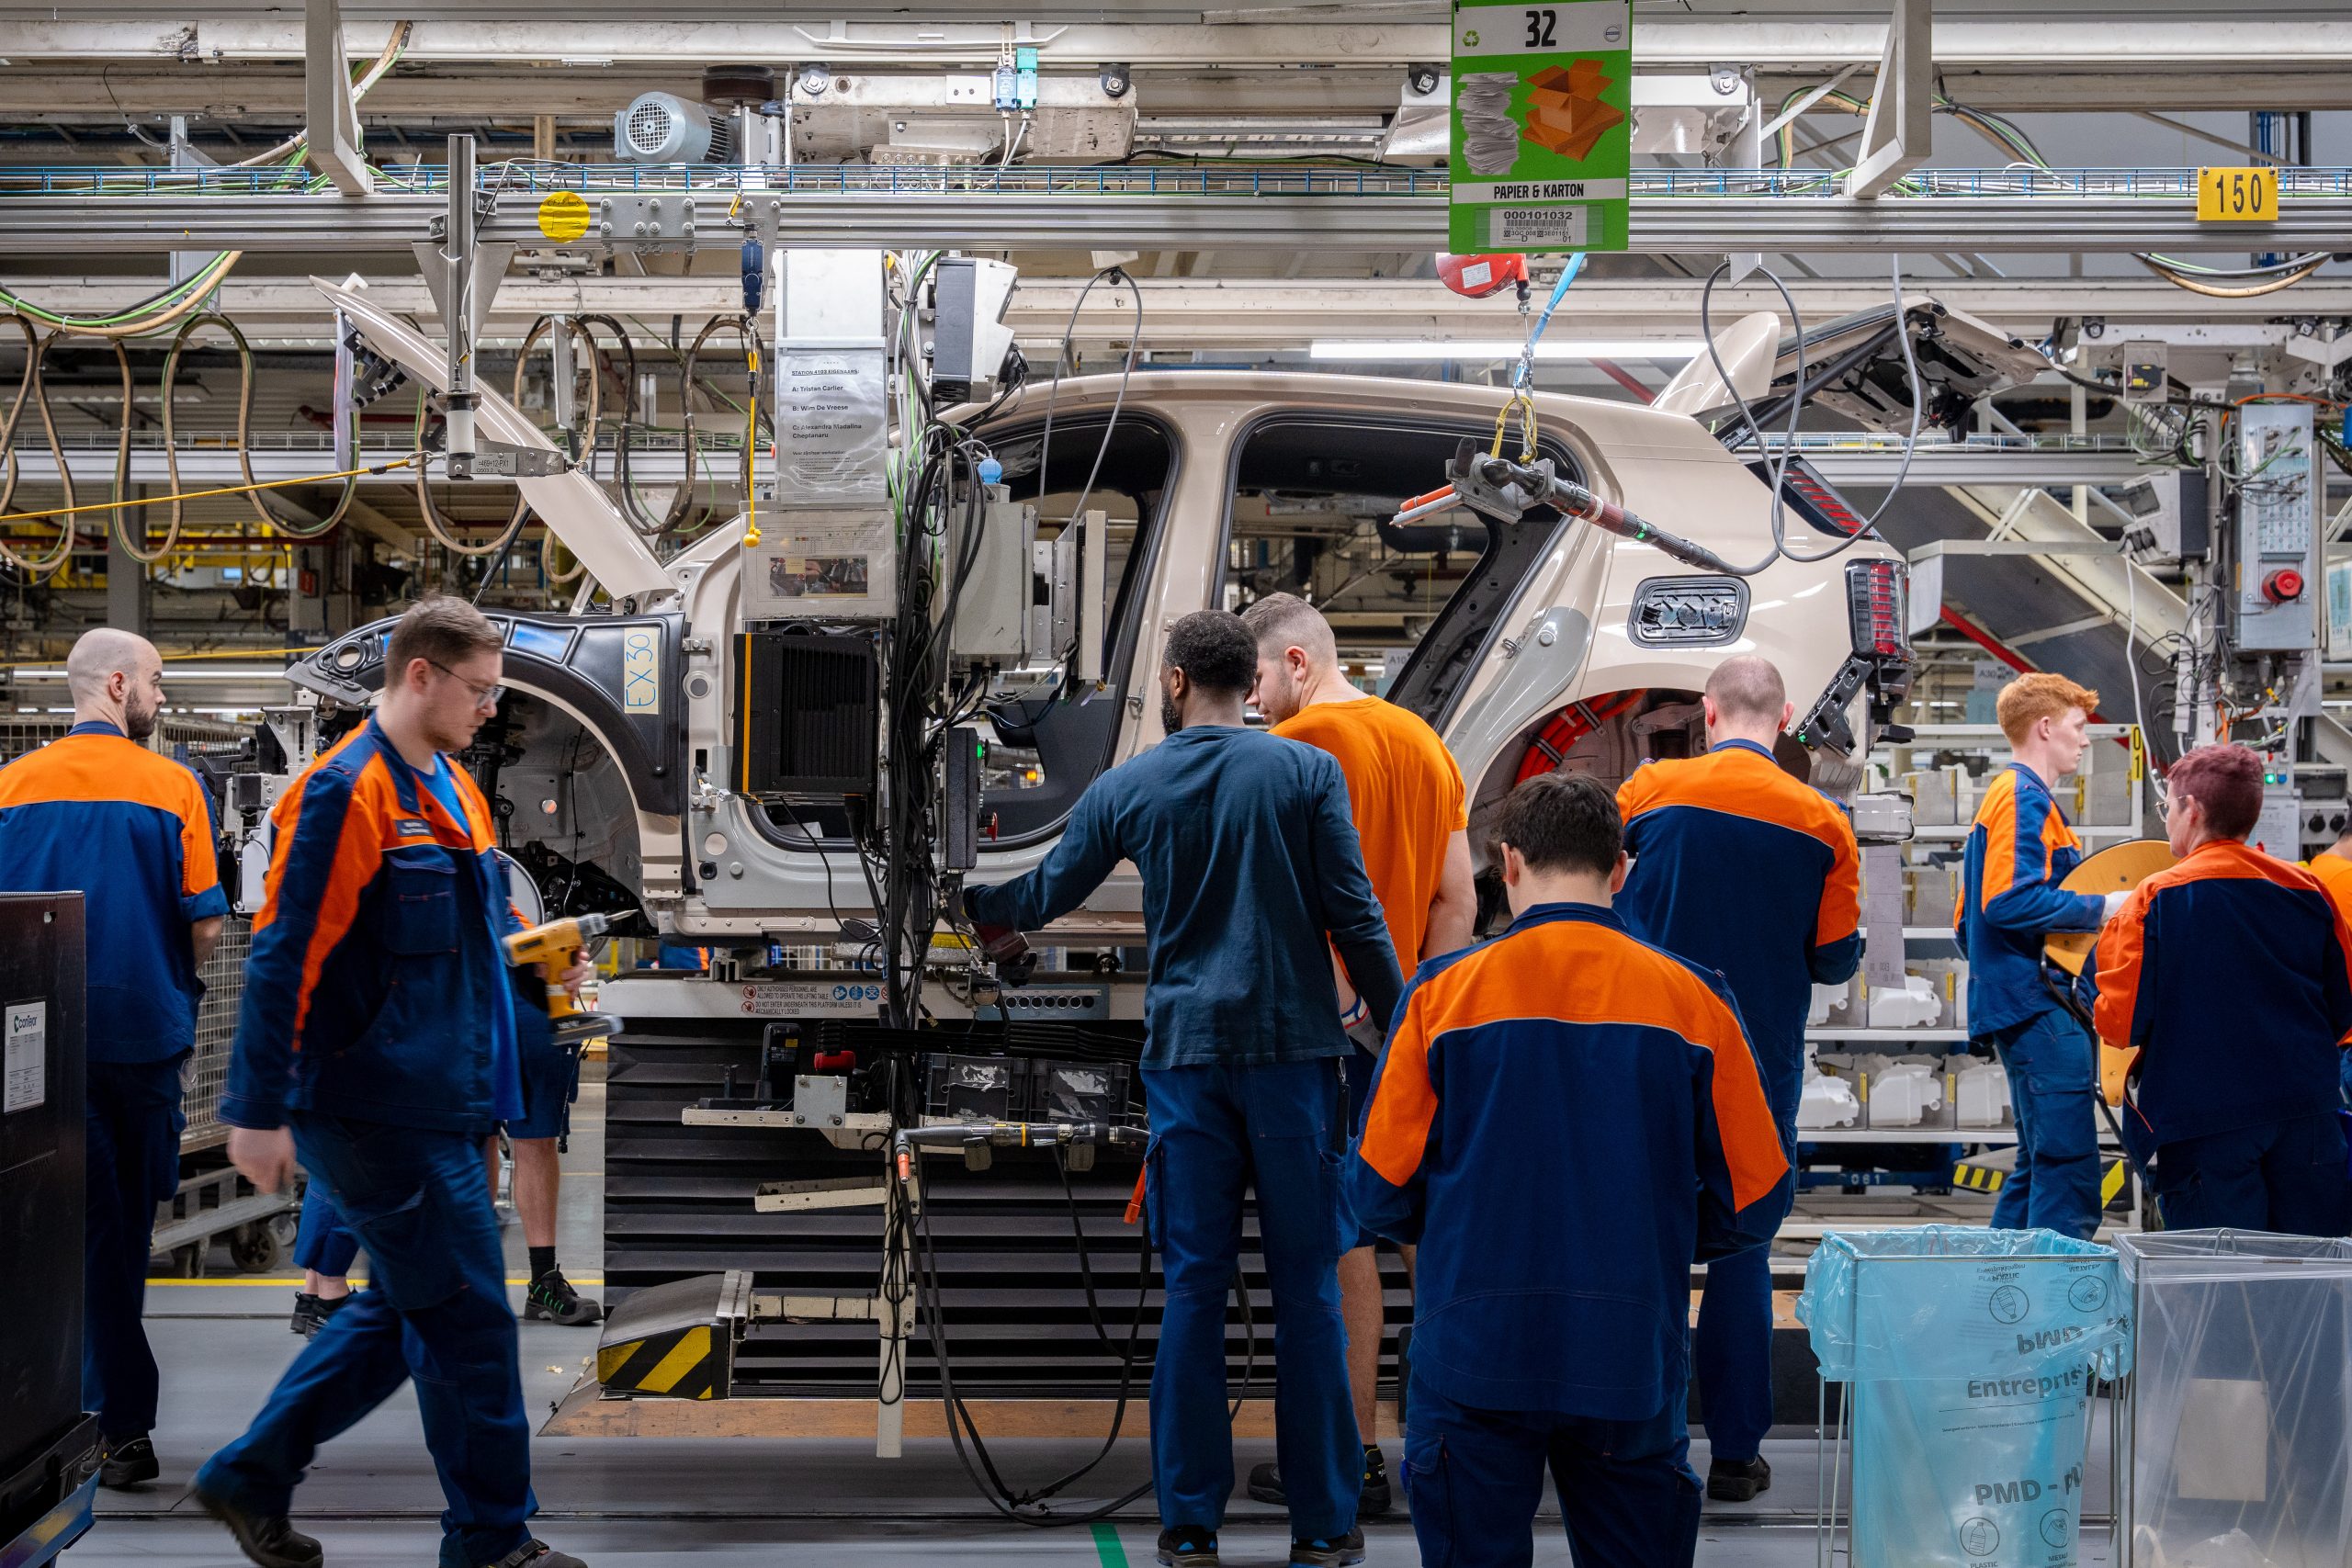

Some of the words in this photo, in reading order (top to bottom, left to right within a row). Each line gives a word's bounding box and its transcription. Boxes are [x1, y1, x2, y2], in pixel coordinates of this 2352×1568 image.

[1525, 9, 1557, 48] 32
[1493, 185, 1530, 199] PAPIER
[1532, 185, 1540, 198] &
[1544, 183, 1584, 198] KARTON
[2216, 174, 2263, 213] 150
[1503, 210, 1573, 220] 000101032
[1974, 1479, 2041, 1506] PMD
